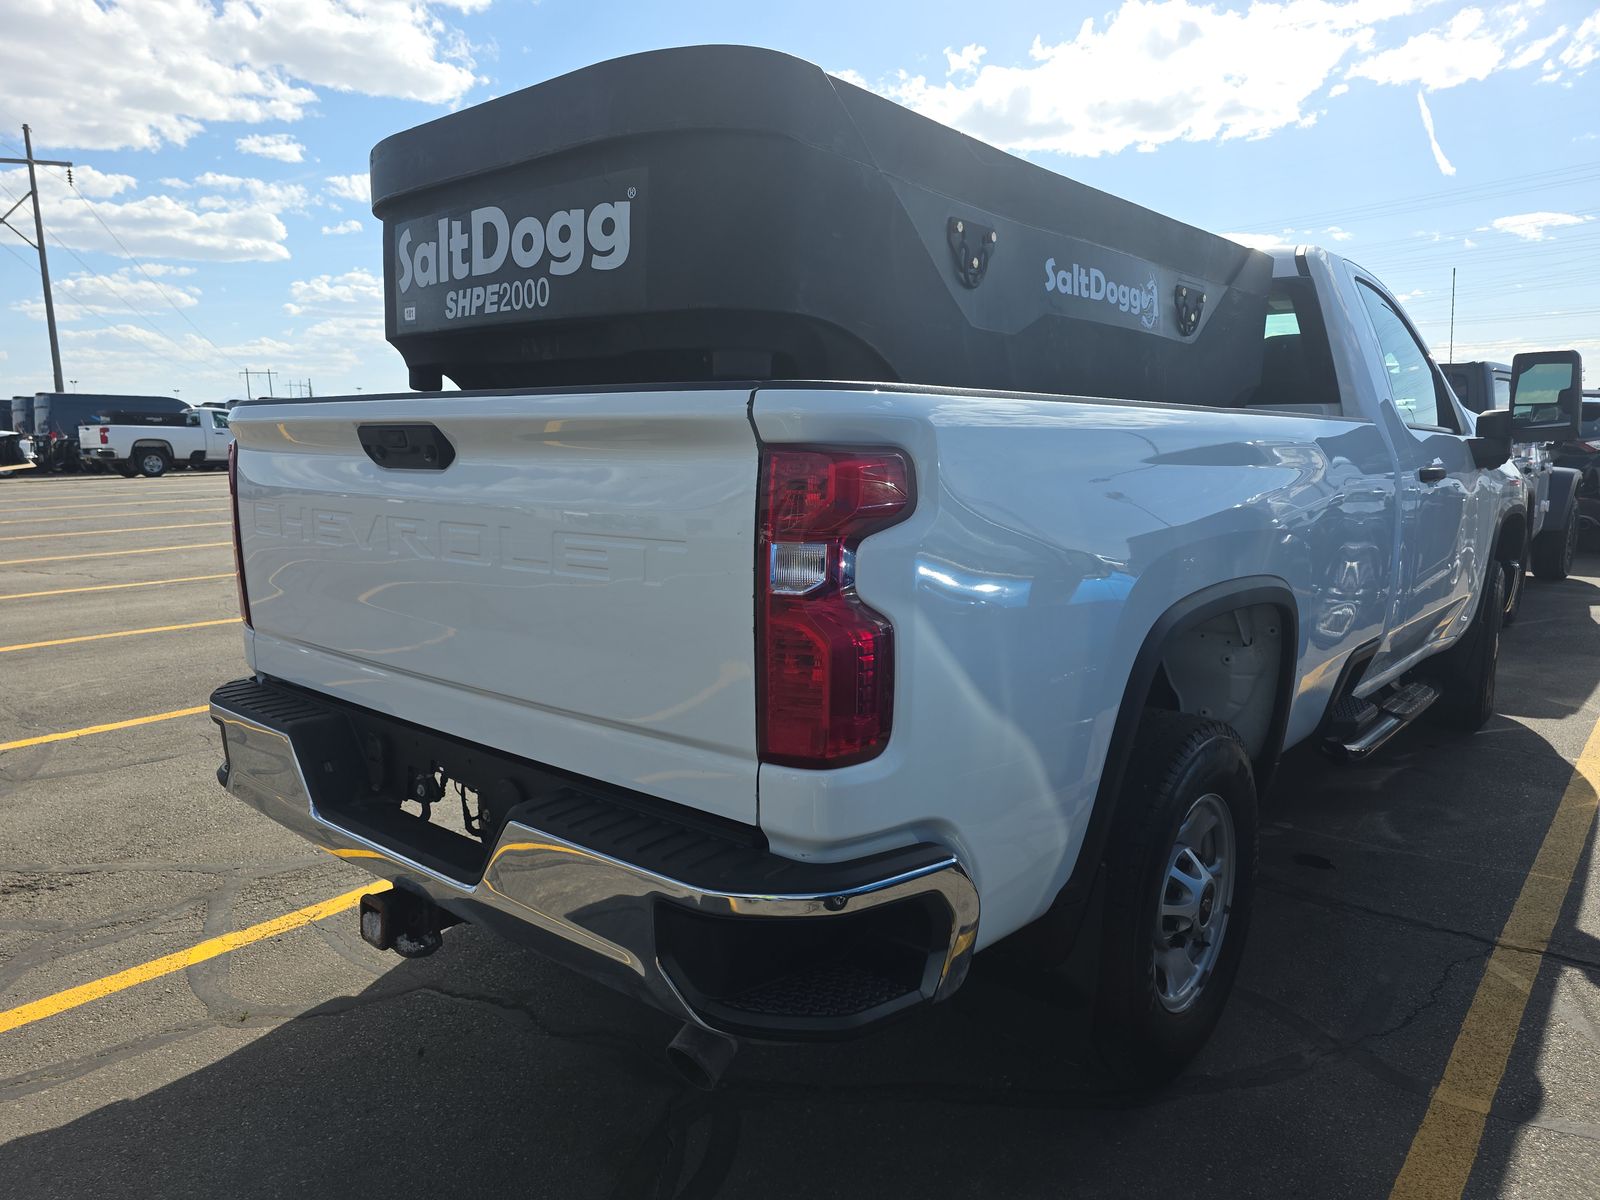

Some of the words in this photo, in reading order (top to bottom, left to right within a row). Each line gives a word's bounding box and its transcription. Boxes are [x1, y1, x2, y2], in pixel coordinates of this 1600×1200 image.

[445, 277, 550, 319] SHPE2000
[1045, 257, 1141, 315] SaltDogg
[254, 502, 688, 586] CHEVROLET
